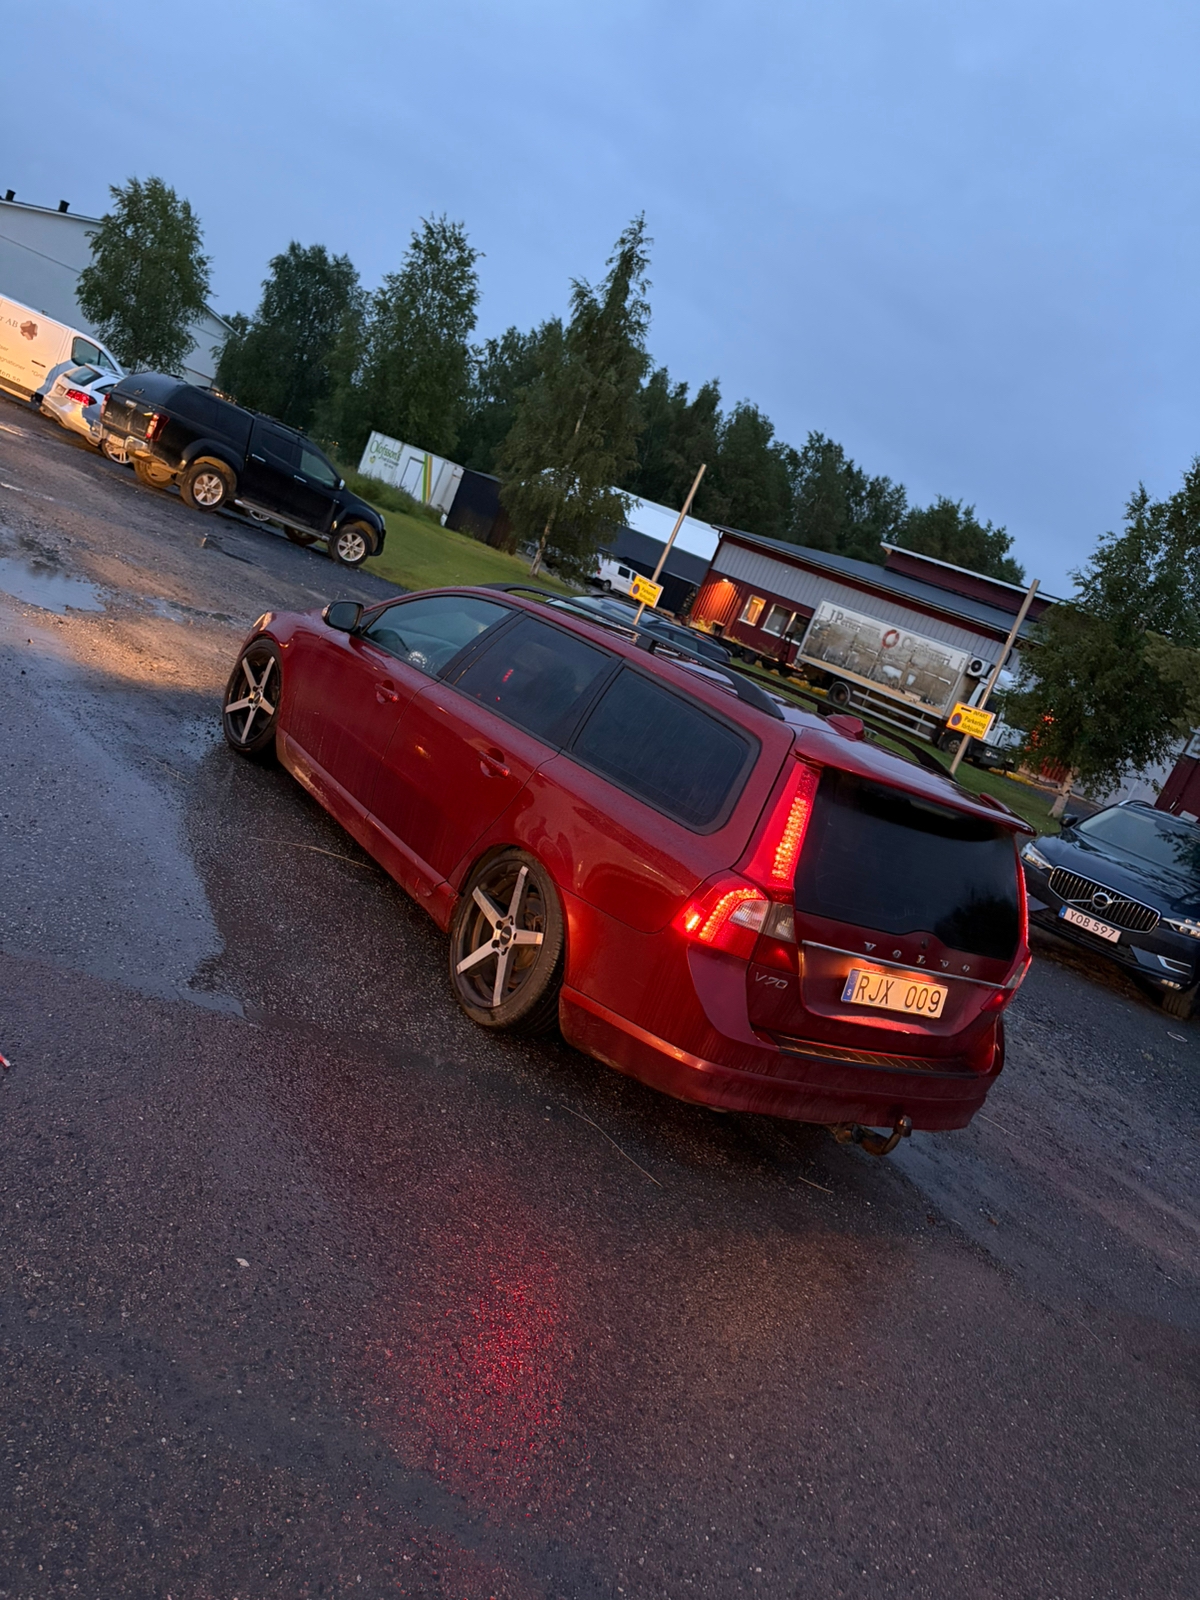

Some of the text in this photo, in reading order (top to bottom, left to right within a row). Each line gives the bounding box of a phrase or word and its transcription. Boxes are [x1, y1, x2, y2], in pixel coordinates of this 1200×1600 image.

[964, 715, 987, 729] Parkering
[972, 710, 989, 719] INFART
[1069, 910, 1116, 938] YOB 597
[864, 941, 970, 972] VOLVO
[755, 971, 789, 990] V70
[855, 975, 895, 1005] RJX
[904, 985, 941, 1013] 009
